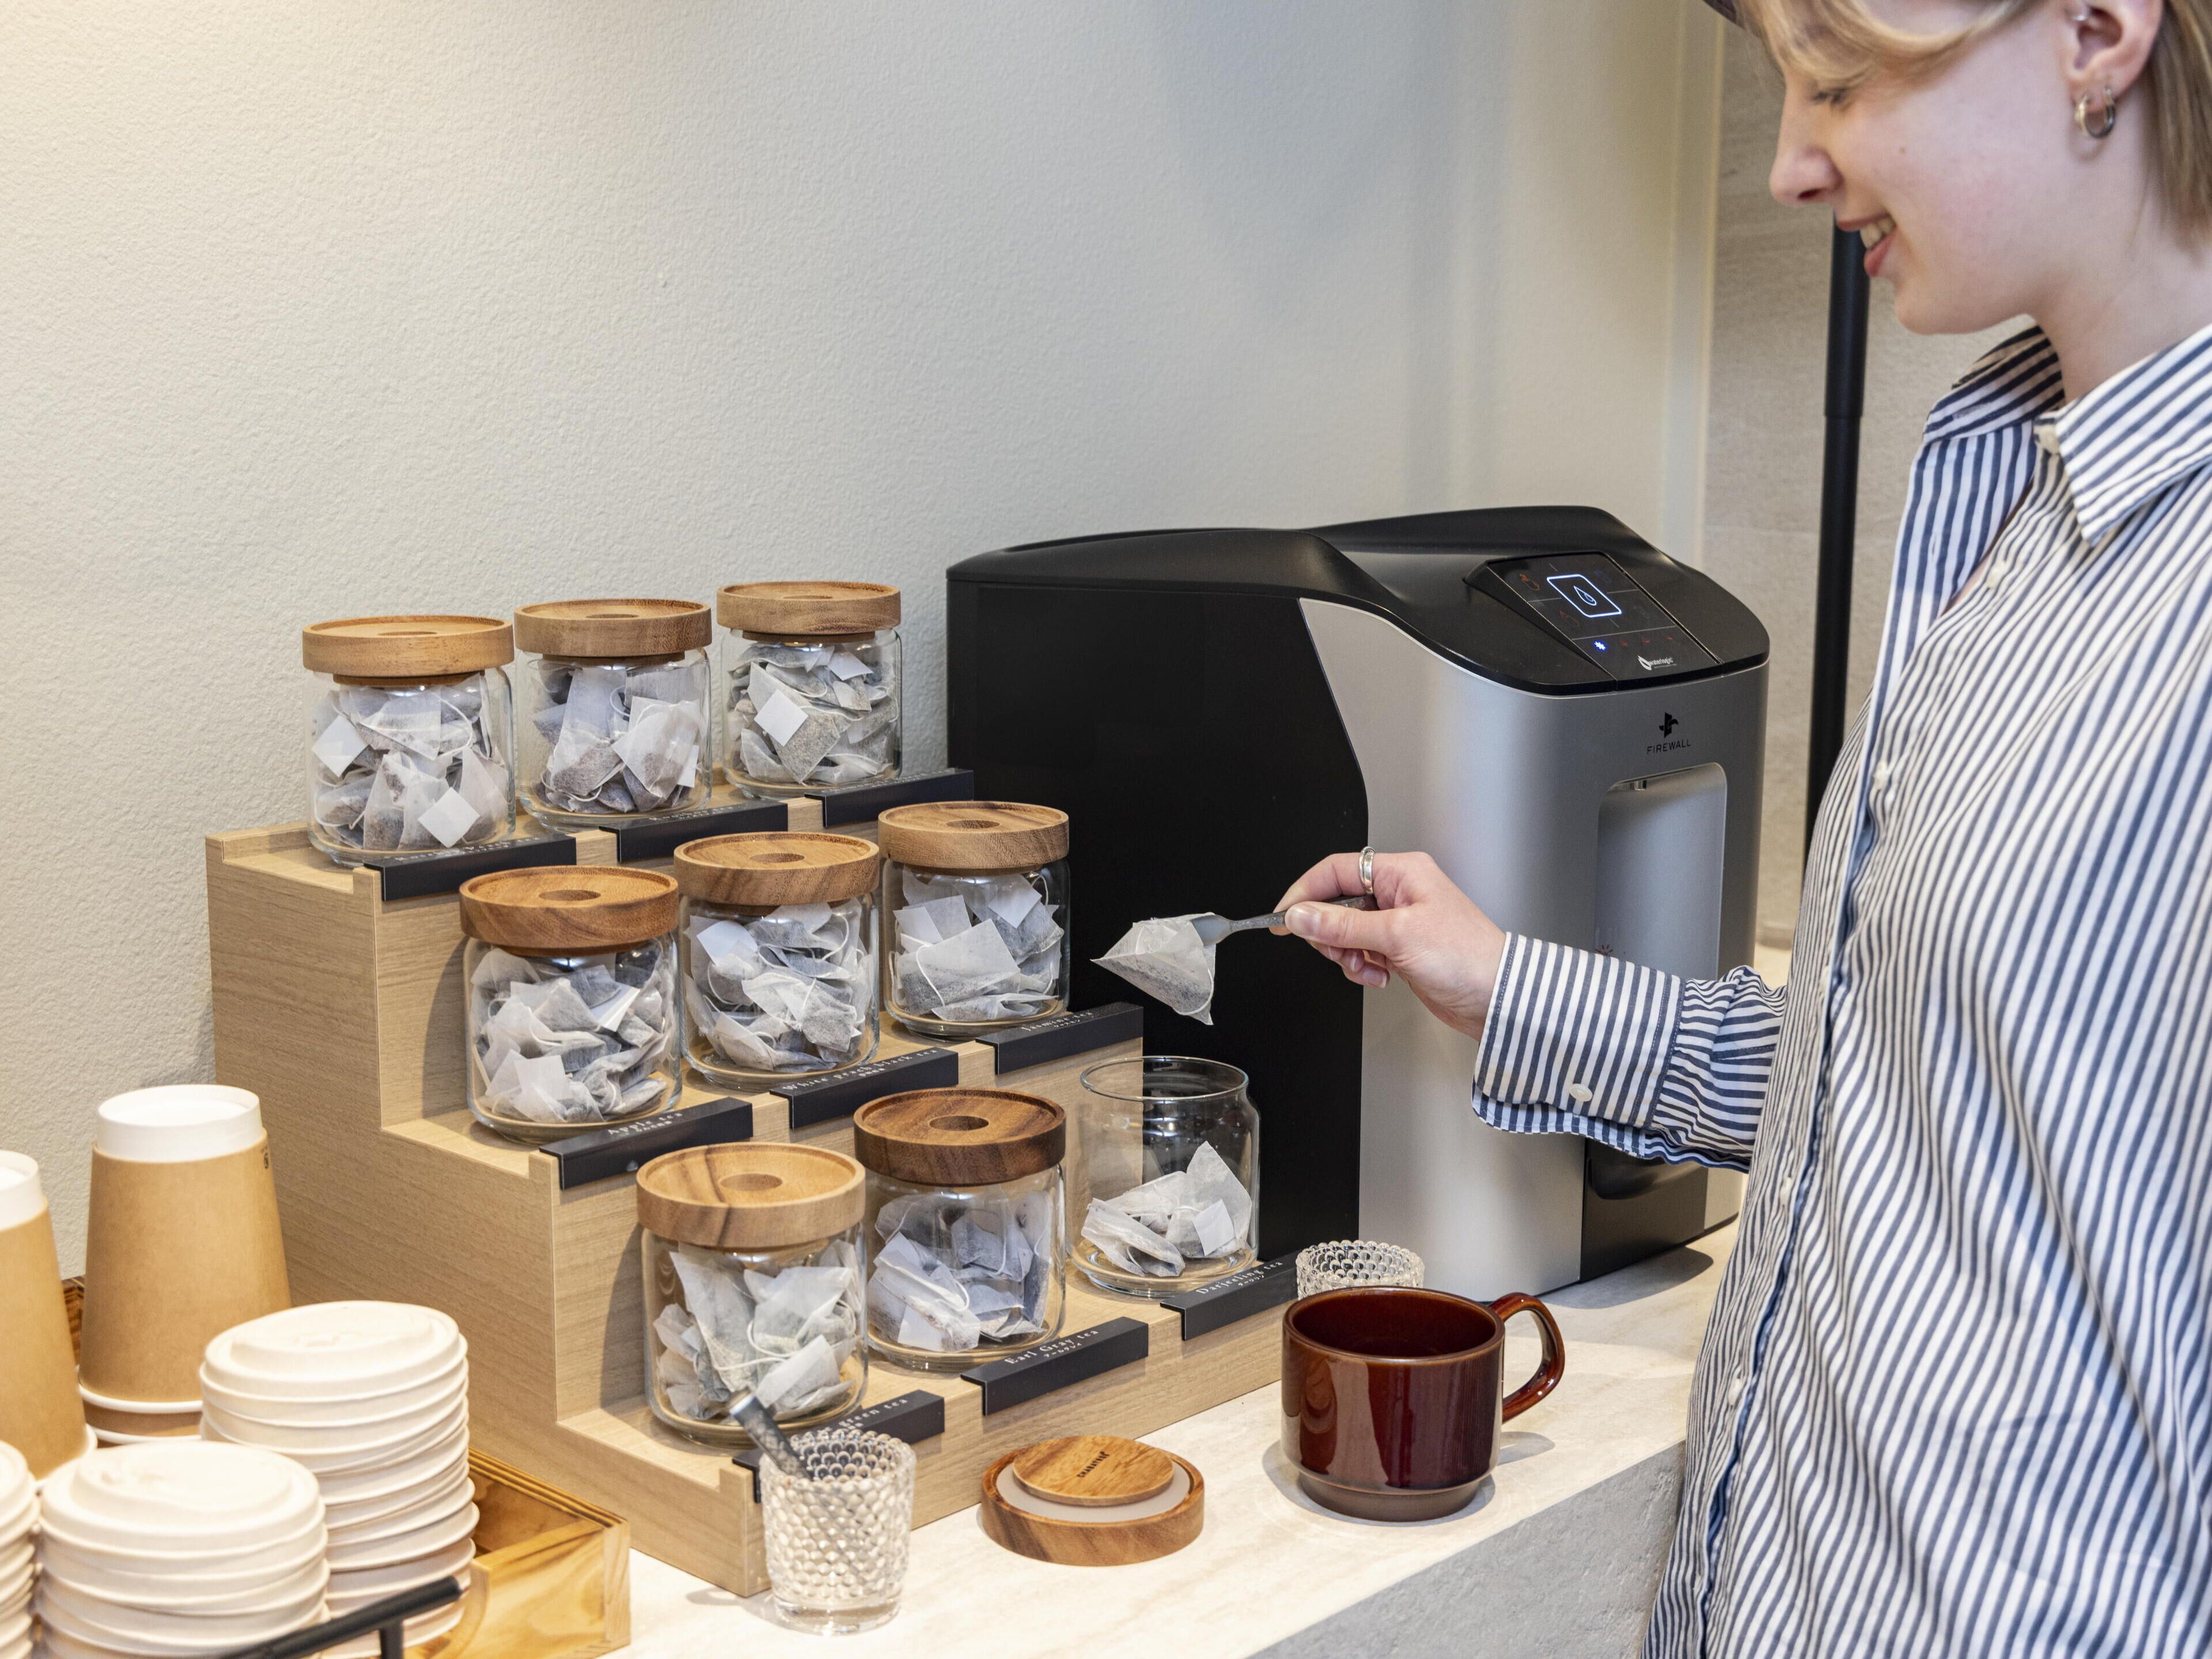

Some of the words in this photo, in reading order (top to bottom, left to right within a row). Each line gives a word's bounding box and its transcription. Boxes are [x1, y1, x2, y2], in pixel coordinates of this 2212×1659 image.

[1647, 738, 1691, 755] FIREWALL
[1021, 1017, 1070, 1031] Jasmine
[782, 1078, 828, 1090] White
[833, 1066, 872, 1079] peach
[873, 1056, 913, 1068] black
[608, 1120, 653, 1135] Apple
[658, 1112, 683, 1121] tea
[1195, 1269, 1264, 1294] Darjeeling
[1263, 1262, 1283, 1270] tea
[1004, 1351, 1037, 1364] Earl
[1039, 1338, 1075, 1352] Gray
[1077, 1330, 1099, 1339] tea
[838, 1409, 880, 1427] green
[883, 1399, 908, 1409] tea
